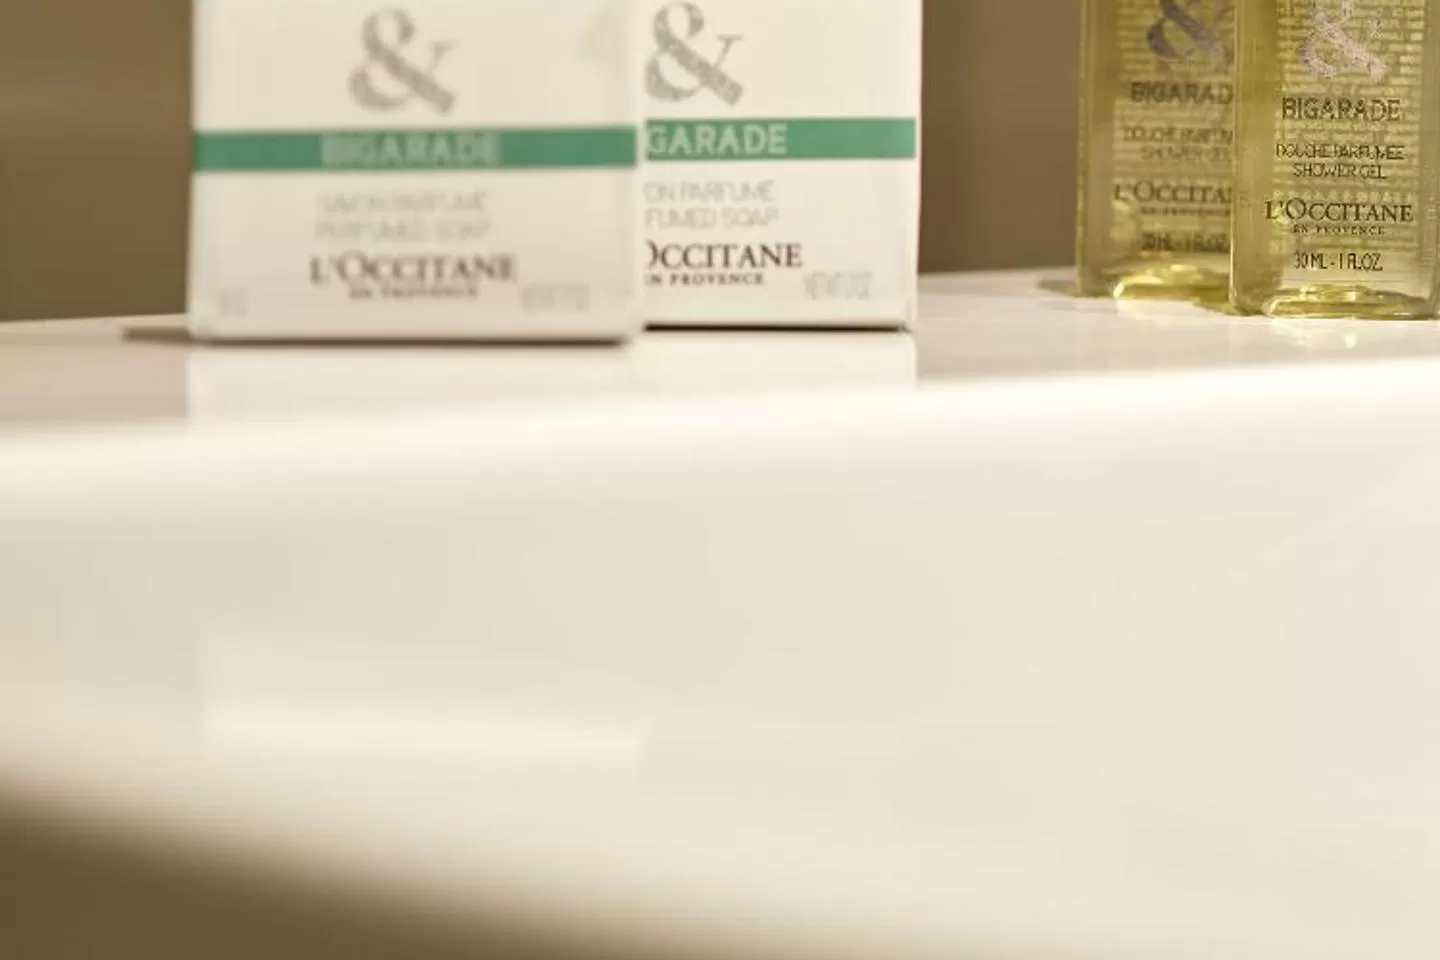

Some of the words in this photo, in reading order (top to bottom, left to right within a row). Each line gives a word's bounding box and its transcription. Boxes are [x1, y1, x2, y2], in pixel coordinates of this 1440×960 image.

[346, 6, 459, 117] &
[644, 0, 745, 107] &
[1130, 82, 1233, 106] BIGARAD
[1282, 97, 1400, 121] BIGARADE
[647, 123, 788, 155] GARADE
[1115, 180, 1231, 204] L'OCCITA
[1265, 197, 1414, 222] L'OCCITANE
[670, 273, 764, 286] PROVENCE
